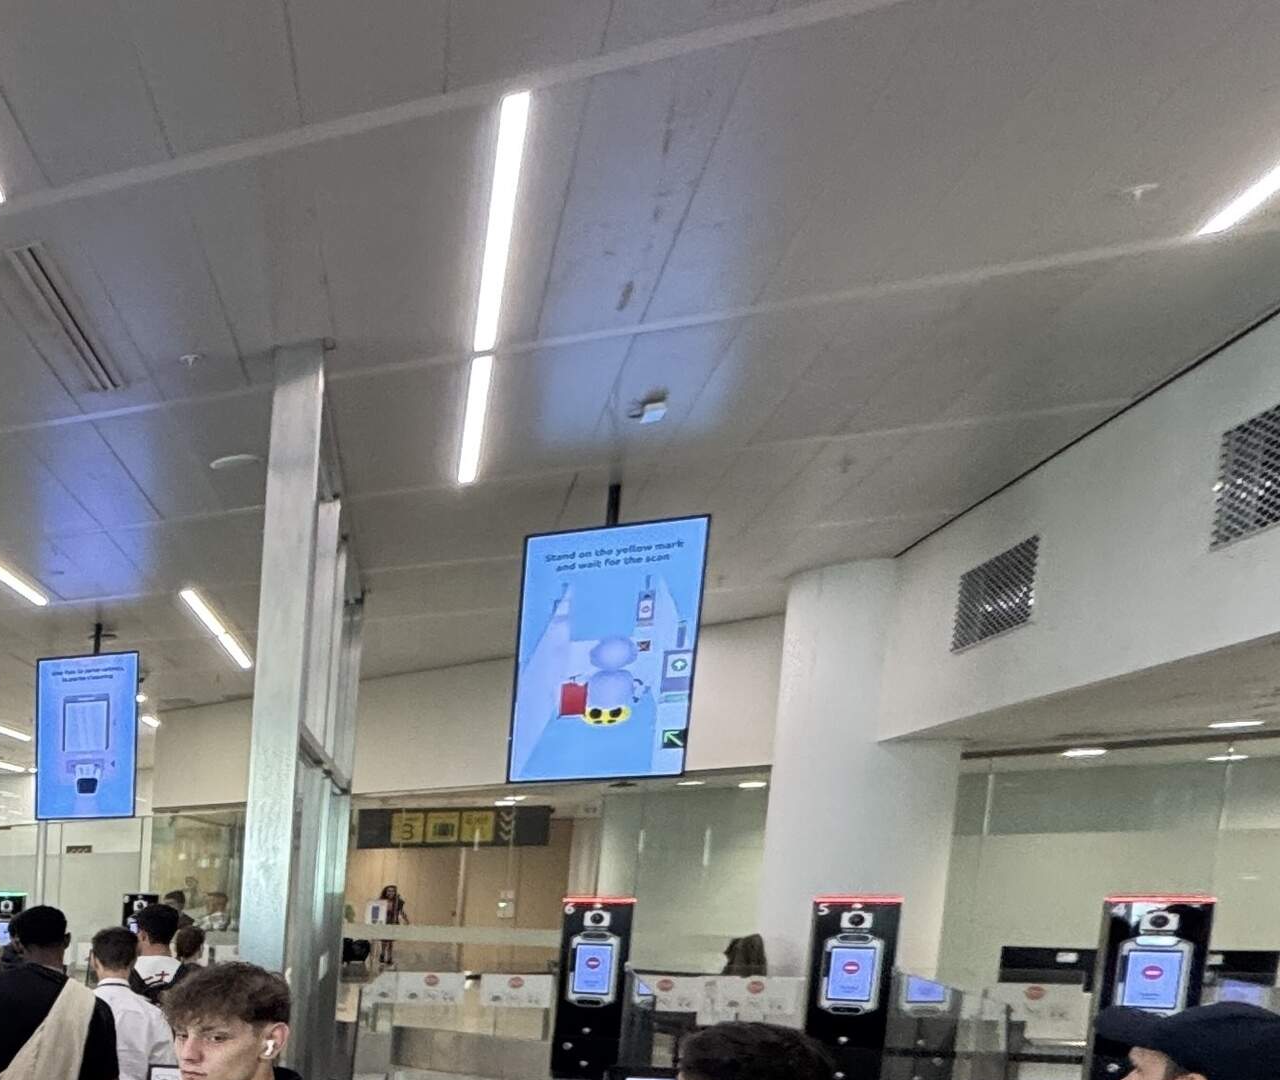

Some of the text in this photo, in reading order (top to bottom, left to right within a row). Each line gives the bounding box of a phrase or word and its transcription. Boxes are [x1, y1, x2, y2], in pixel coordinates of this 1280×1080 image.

[545, 539, 684, 563] Stand on the yellow mark
[556, 553, 670, 572] and wait for the scan
[564, 903, 576, 915] 6
[817, 903, 831, 916] 5
